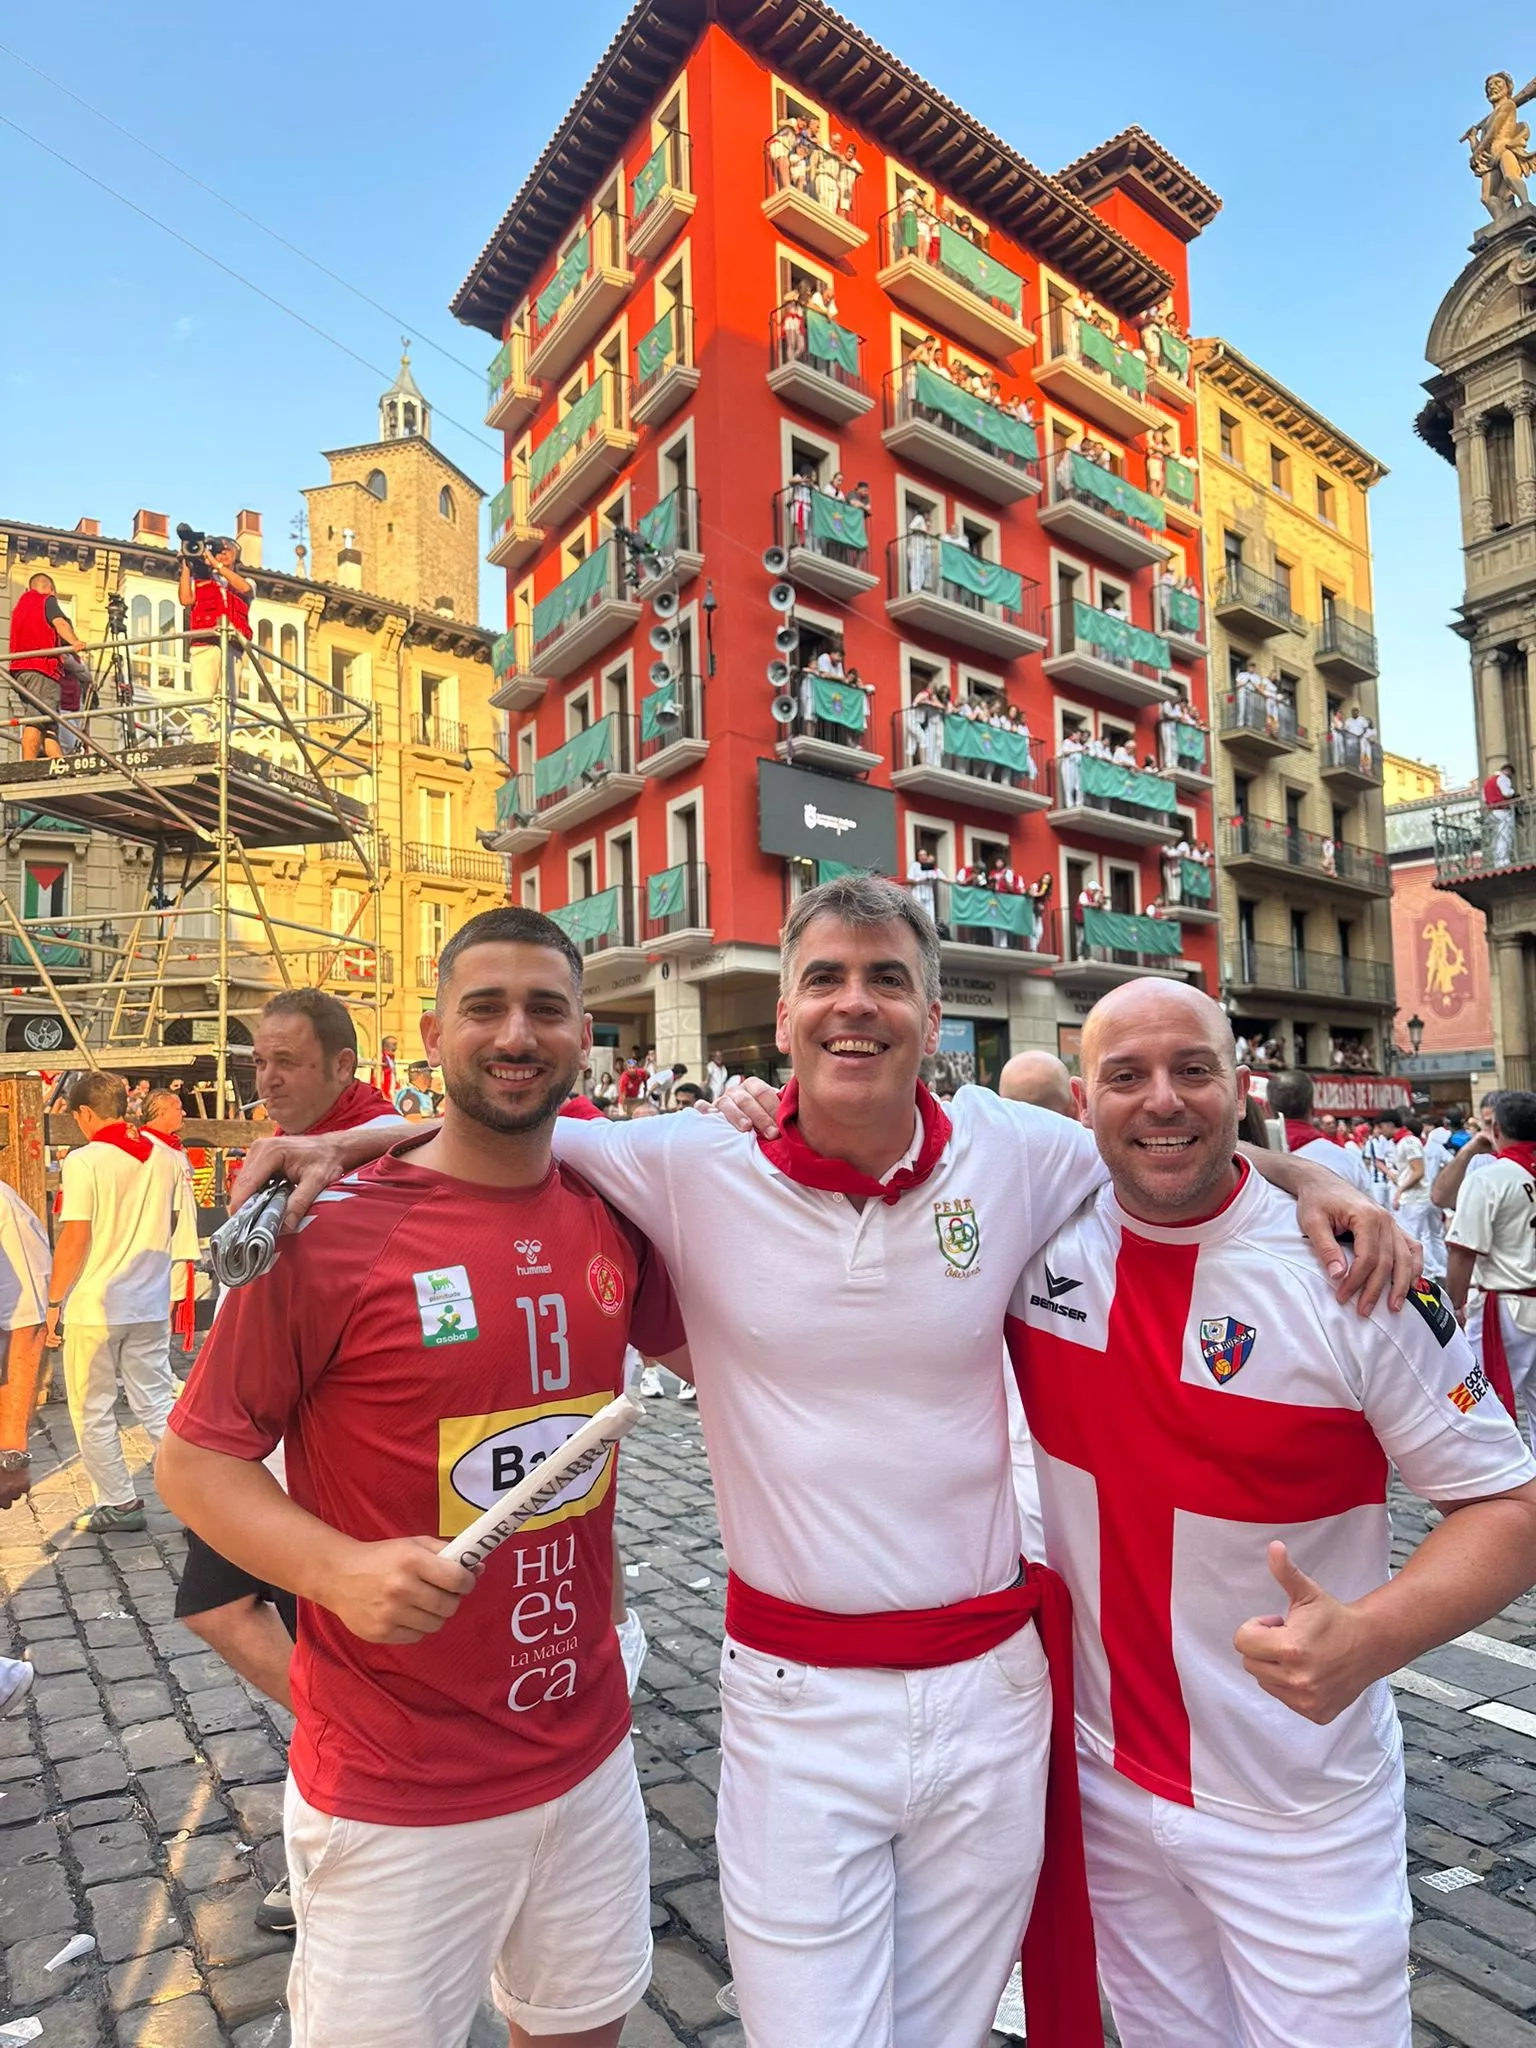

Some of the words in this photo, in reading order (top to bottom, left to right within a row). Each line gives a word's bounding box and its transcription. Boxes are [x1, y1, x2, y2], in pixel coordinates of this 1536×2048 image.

[74, 758, 96, 769] 605
[126, 752, 149, 765] 565
[516, 1263, 552, 1276] hummel
[435, 1331, 468, 1345] asobal
[516, 1293, 570, 1394] 13
[1472, 1384, 1486, 1402] DE
[476, 1520, 517, 1551] DE
[510, 1438, 619, 1522] NAVARRA
[513, 1533, 576, 1588] Hu
[511, 1579, 577, 1644] es
[511, 1652, 529, 1668] La
[507, 1657, 577, 1712] ca
